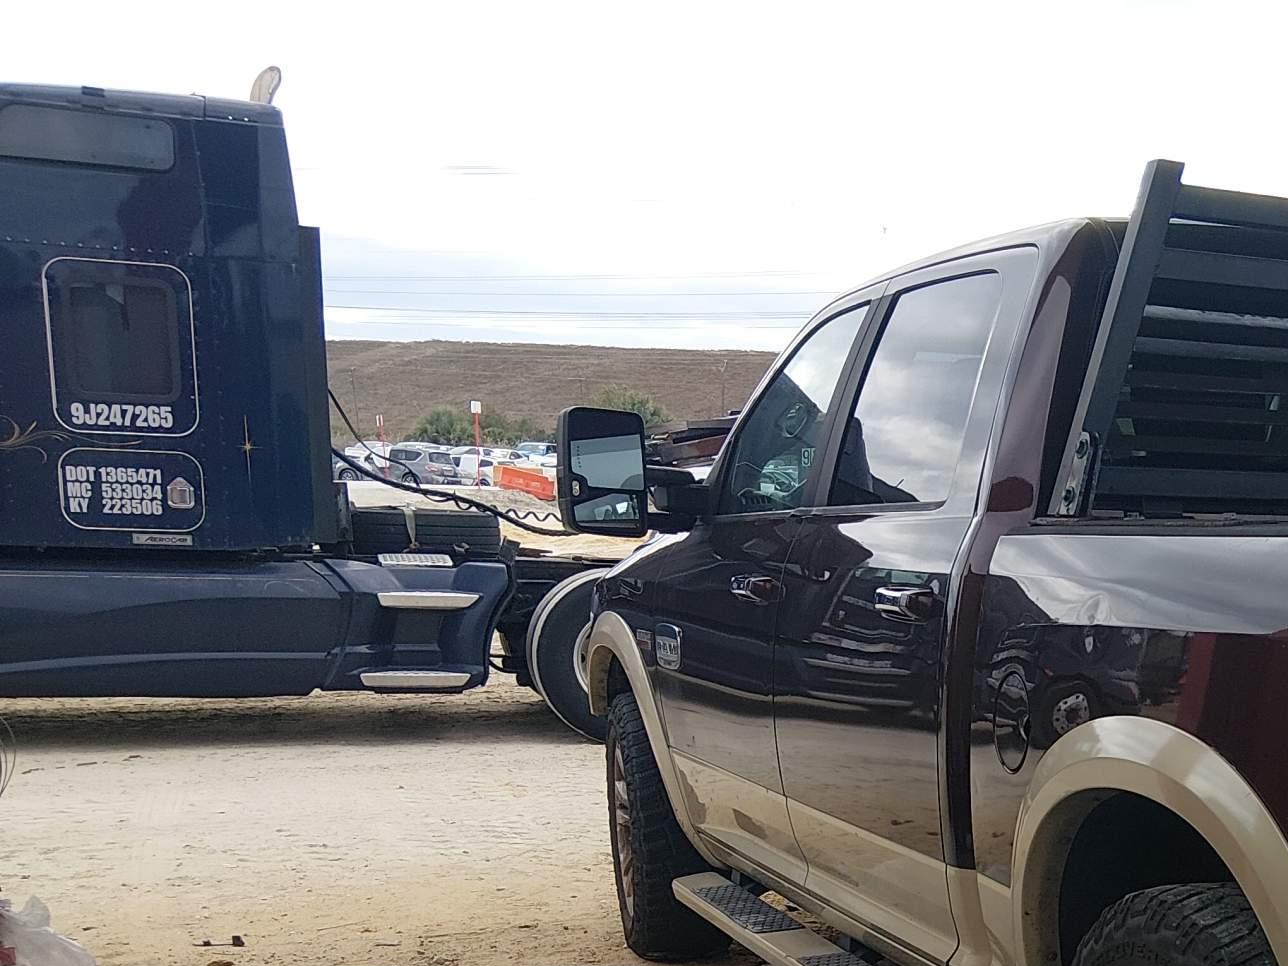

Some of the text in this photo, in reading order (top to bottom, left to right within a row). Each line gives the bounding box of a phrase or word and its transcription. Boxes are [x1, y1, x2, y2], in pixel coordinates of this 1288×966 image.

[71, 403, 174, 428] 9J247265
[65, 465, 162, 483] DOT 1365471
[67, 482, 163, 499] MC 533034
[69, 498, 163, 516] KY 223506
